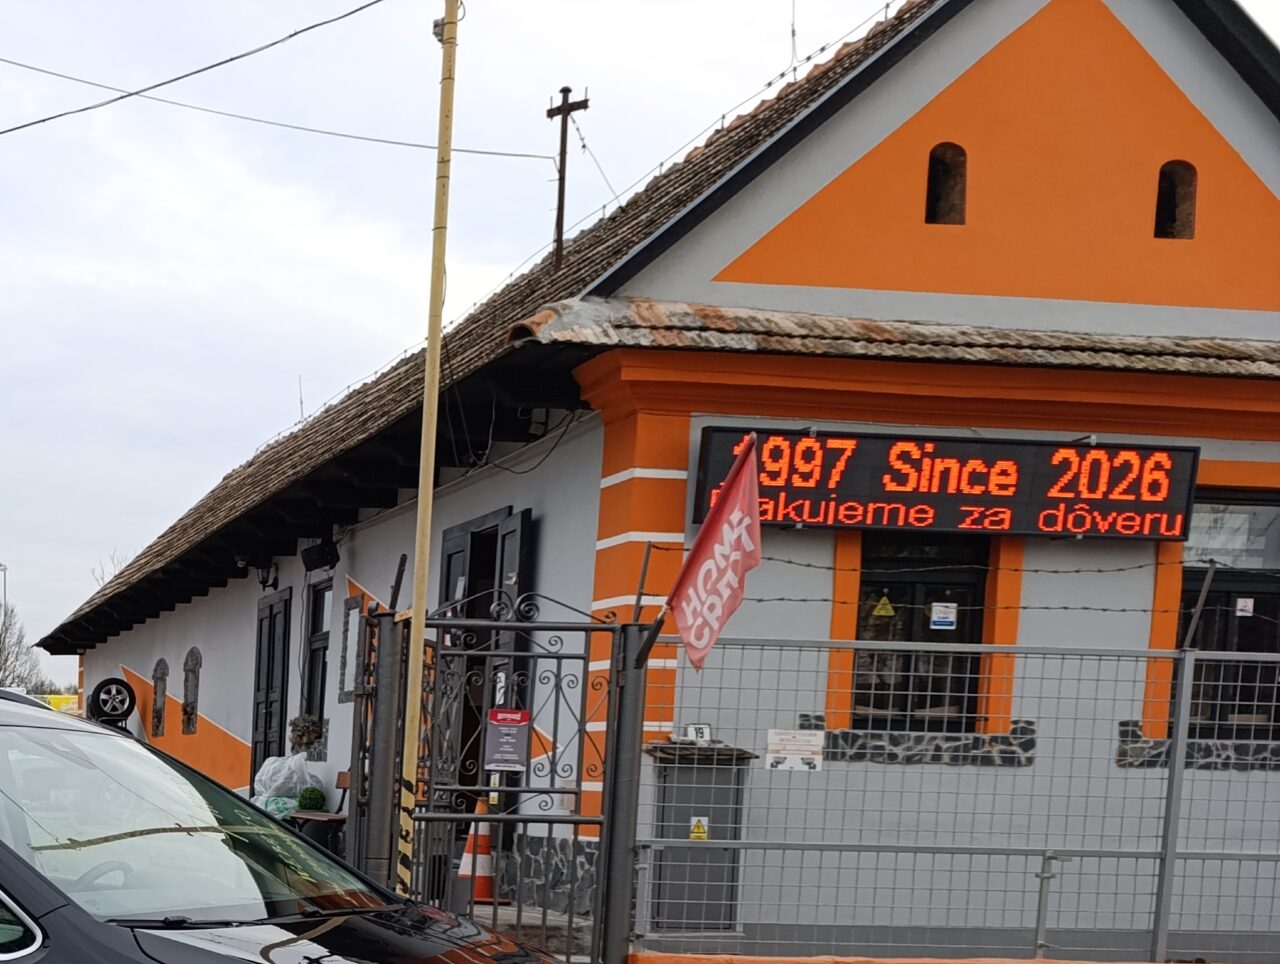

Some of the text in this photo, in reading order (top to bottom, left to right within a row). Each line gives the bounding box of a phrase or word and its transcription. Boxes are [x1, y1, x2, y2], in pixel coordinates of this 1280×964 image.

[882, 441, 1018, 496] Since
[1047, 448, 1172, 502] 2026
[710, 481, 1183, 537] akujeme za dôveru
[694, 726, 705, 739] 19
